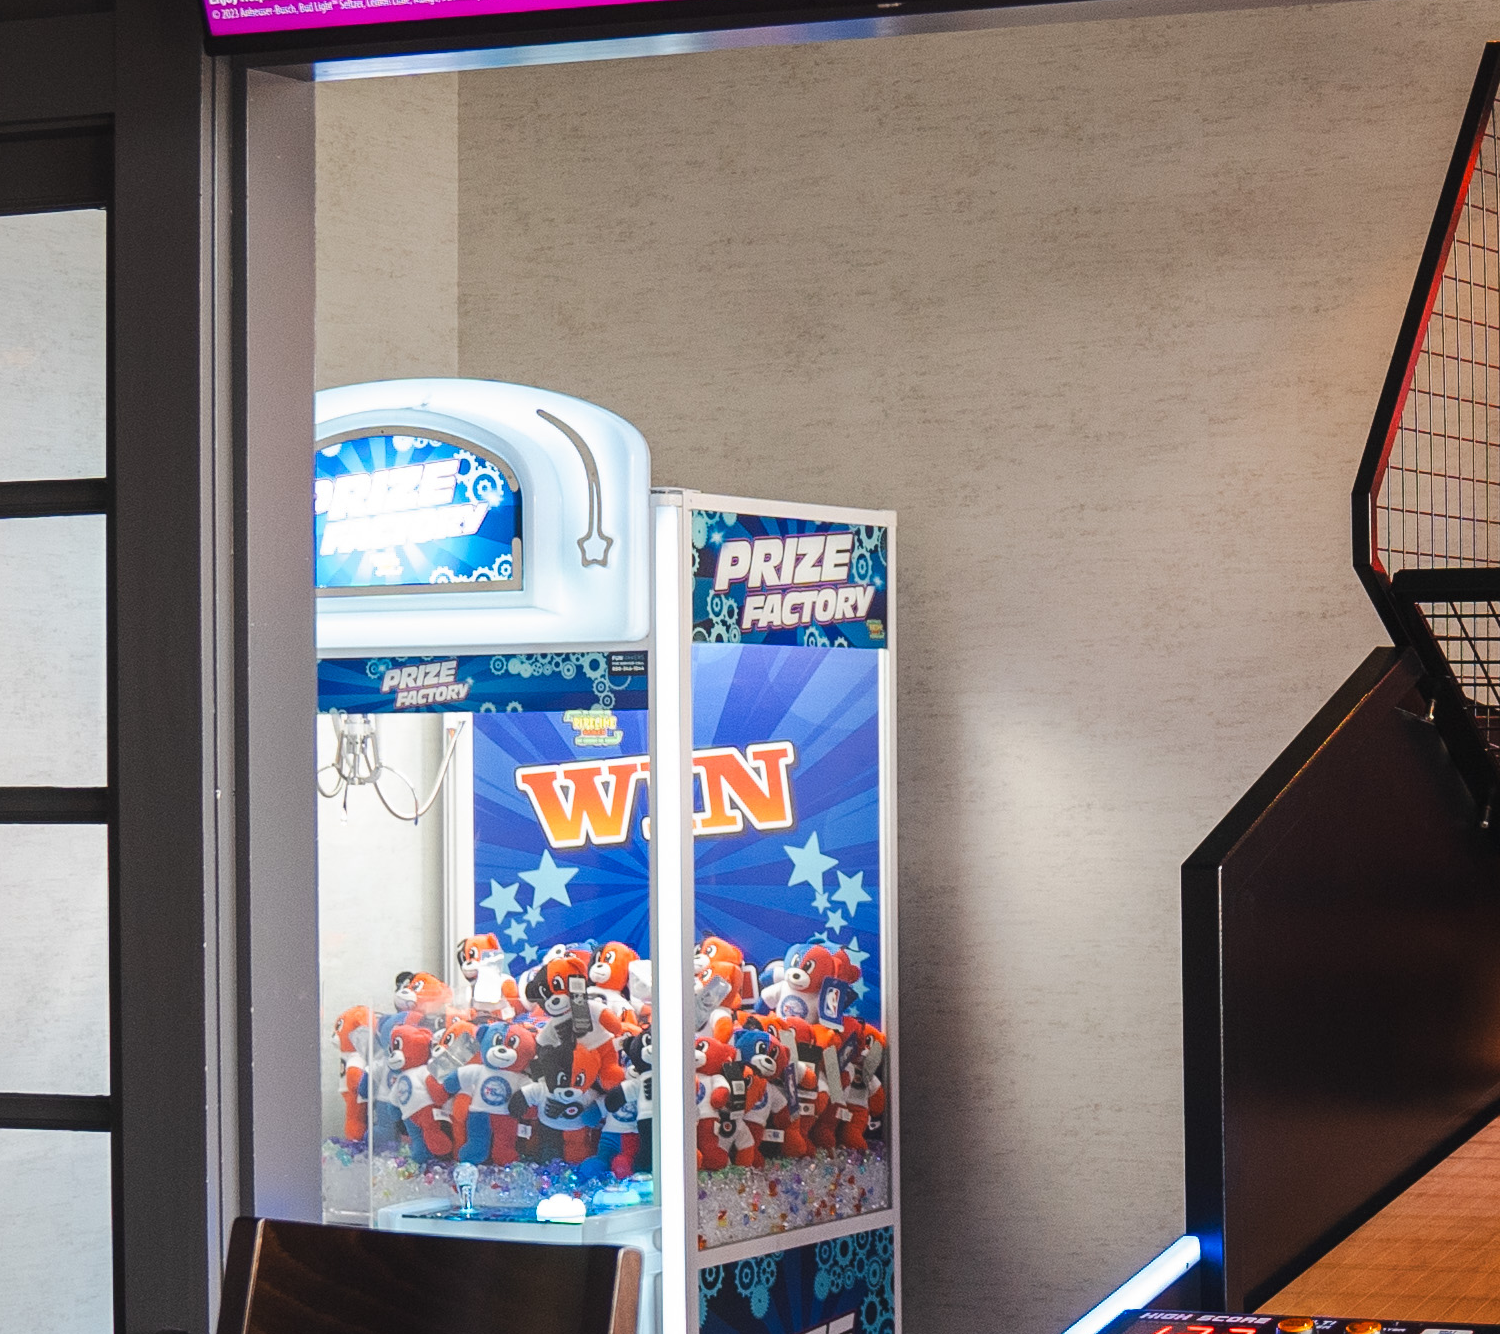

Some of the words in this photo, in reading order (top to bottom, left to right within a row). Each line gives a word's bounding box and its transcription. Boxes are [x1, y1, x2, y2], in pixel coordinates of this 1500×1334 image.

[713, 531, 855, 592] PRIZE
[741, 585, 875, 632] FACTORY
[382, 660, 458, 695] PRIZE
[394, 681, 470, 708] FACTORY
[1138, 1312, 1190, 1322] HIGH
[1195, 1315, 1273, 1325] SCORE
